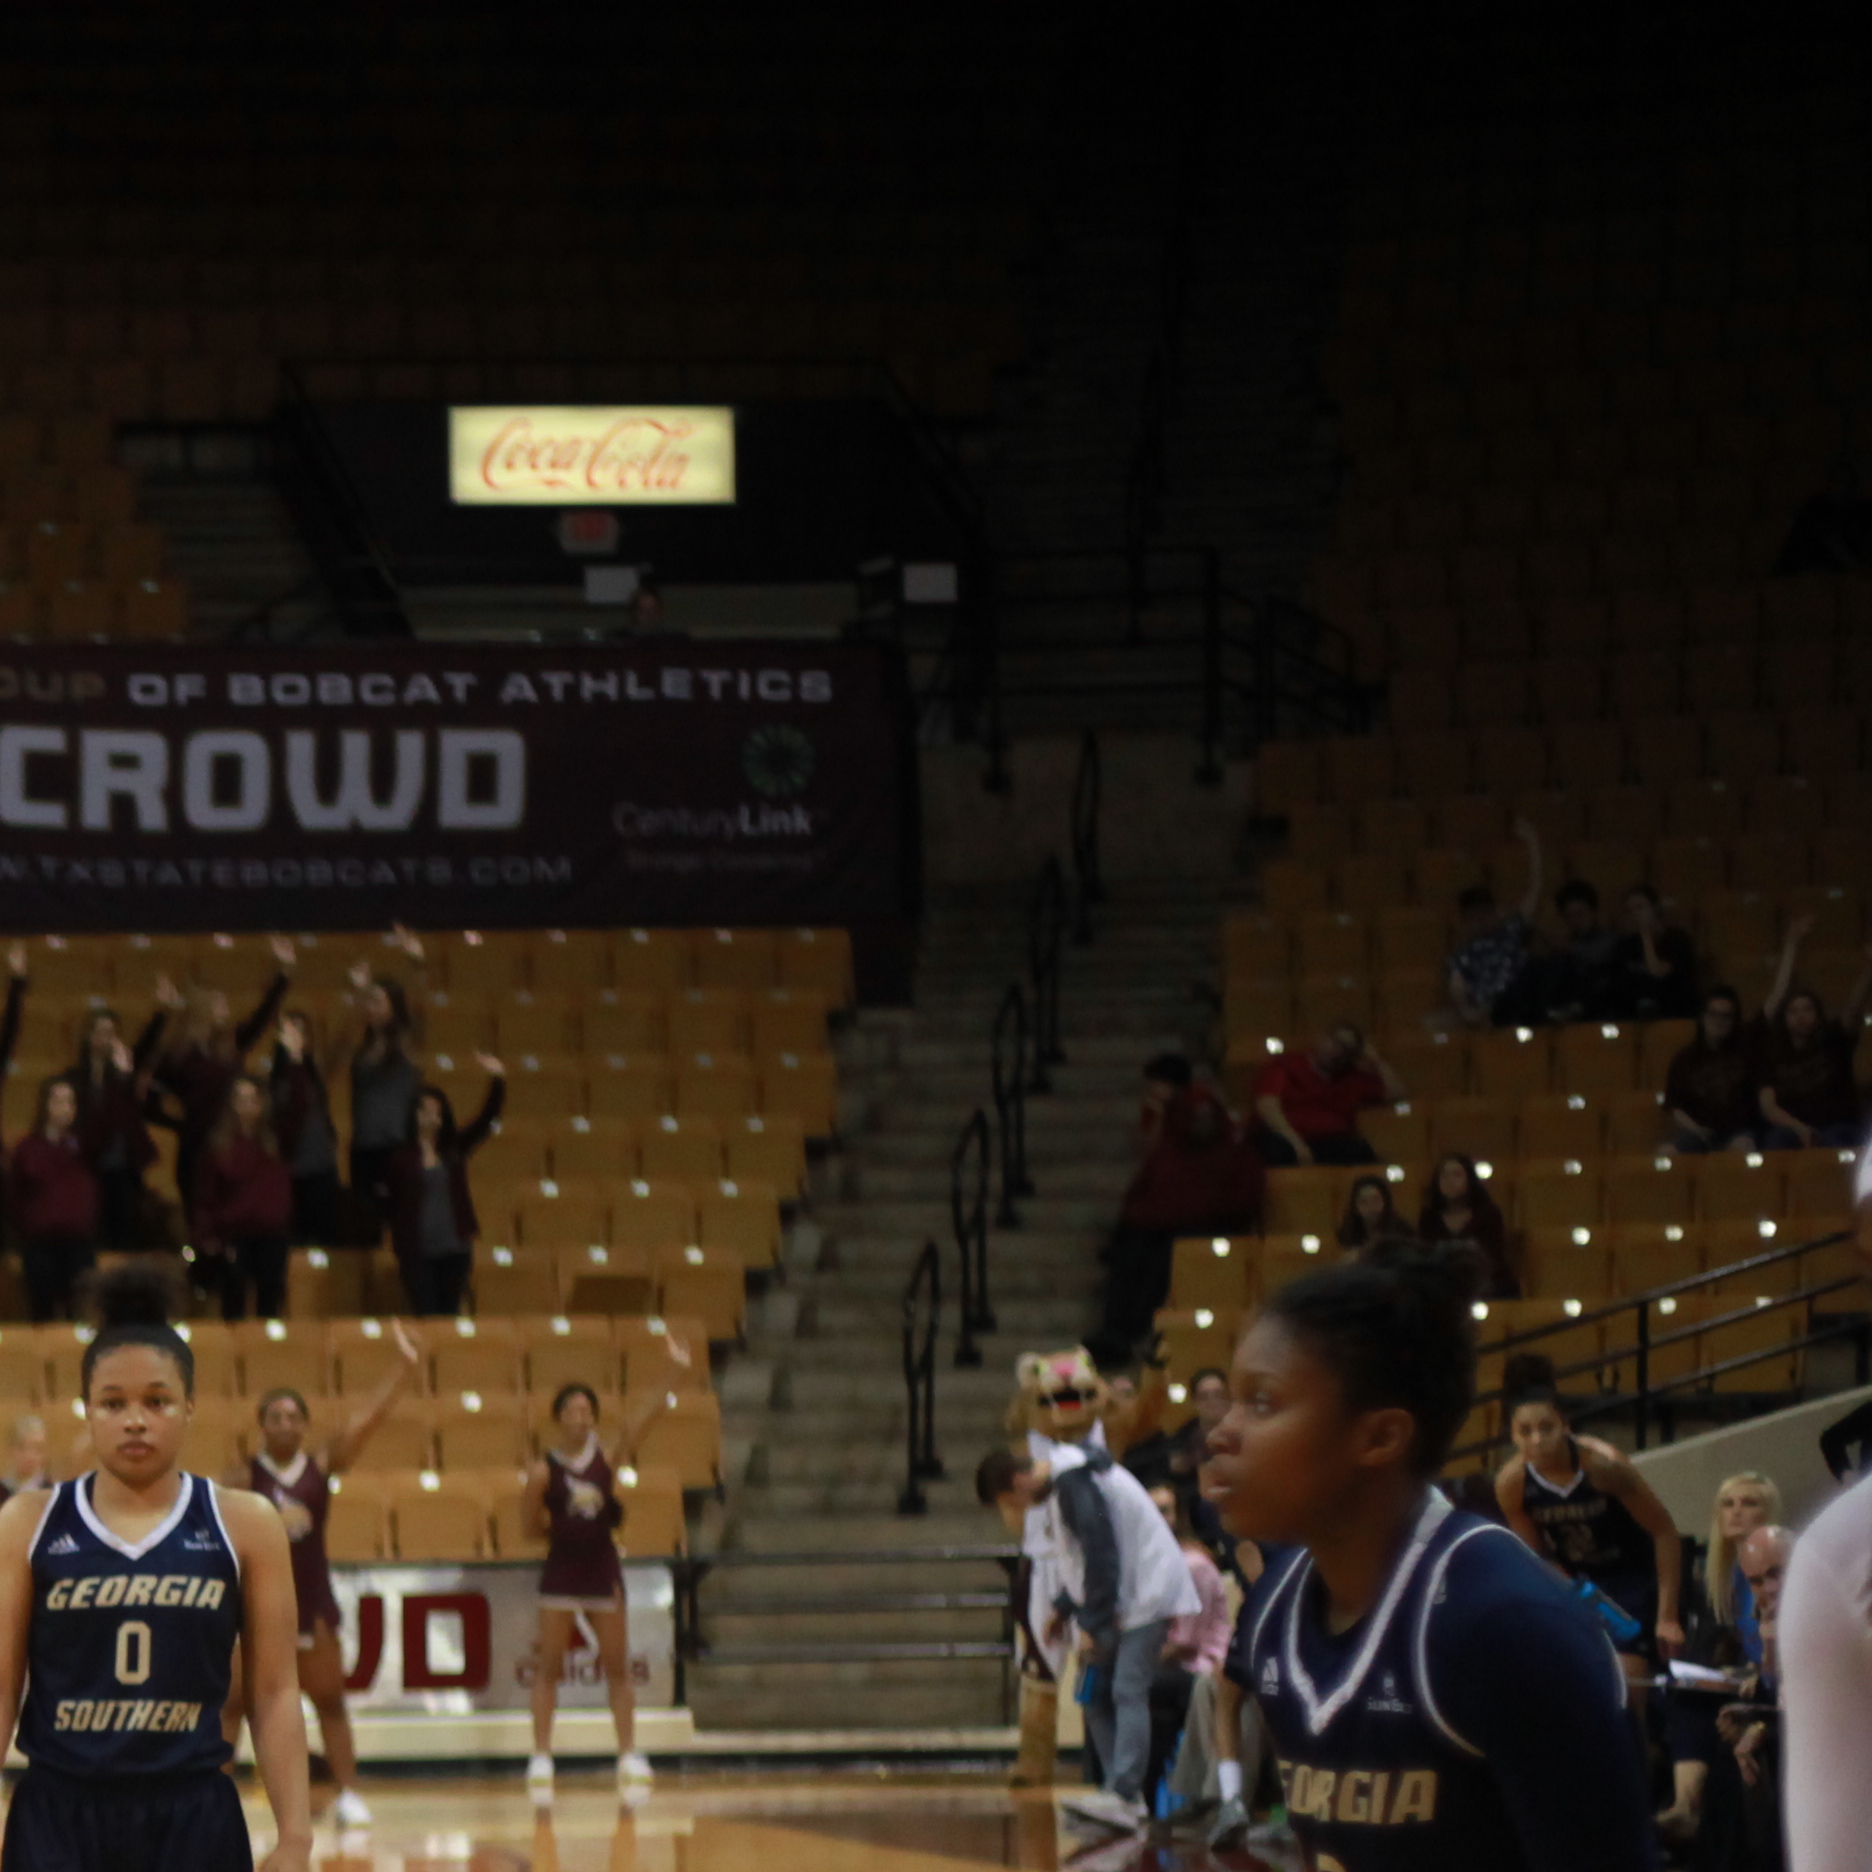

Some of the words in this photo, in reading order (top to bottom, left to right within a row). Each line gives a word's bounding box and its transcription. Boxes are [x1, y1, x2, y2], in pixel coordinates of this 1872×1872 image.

[126, 671, 208, 708] OF
[227, 670, 479, 707] BOBCAT
[500, 666, 833, 704] ATHLETICS
[45, 1573, 227, 1611] GEORGIA
[113, 1619, 153, 1686] 0
[53, 1698, 204, 1733] SOUTHERN
